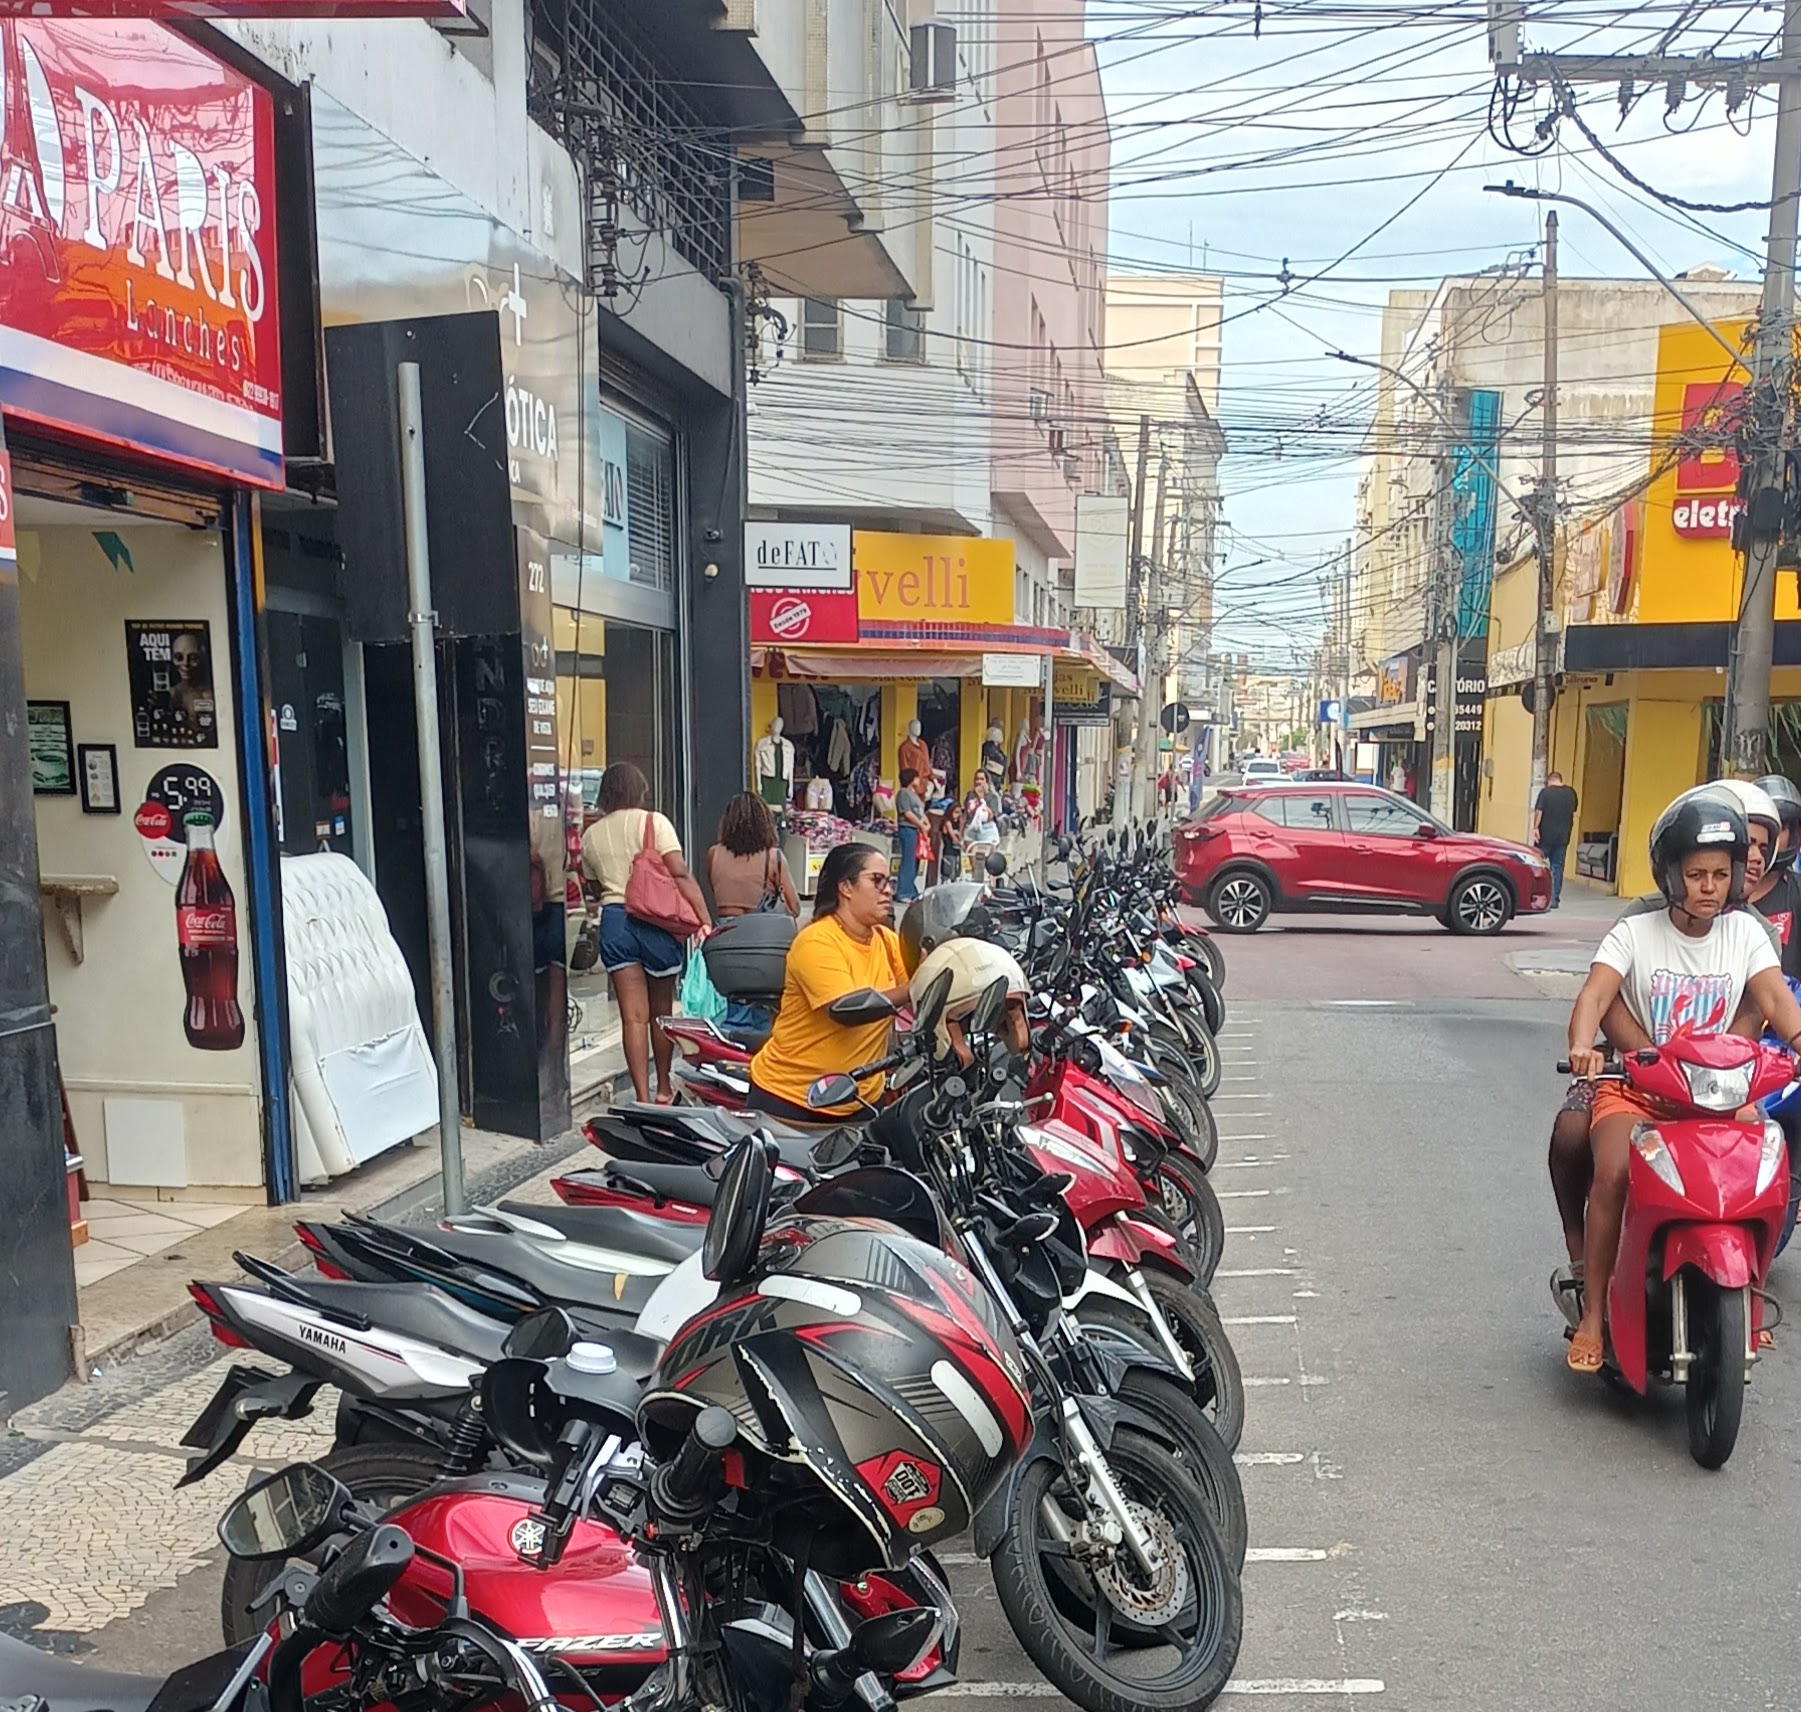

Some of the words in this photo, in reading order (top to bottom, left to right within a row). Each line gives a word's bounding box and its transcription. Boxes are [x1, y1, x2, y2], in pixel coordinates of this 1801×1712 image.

[74, 85, 266, 323] PARIS
[126, 279, 241, 371] Lanches
[506, 375, 559, 461] ÓTICA
[1673, 500, 1747, 529] eletr
[528, 561, 544, 593] 272
[858, 555, 970, 609] velli
[140, 633, 170, 648] AQUI
[143, 648, 172, 661] TEM
[1054, 683, 1083, 695] velli
[1427, 677, 1485, 693] CÓRIO
[299, 1324, 346, 1354] YAMAHA
[514, 1632, 663, 1652] FAZER
